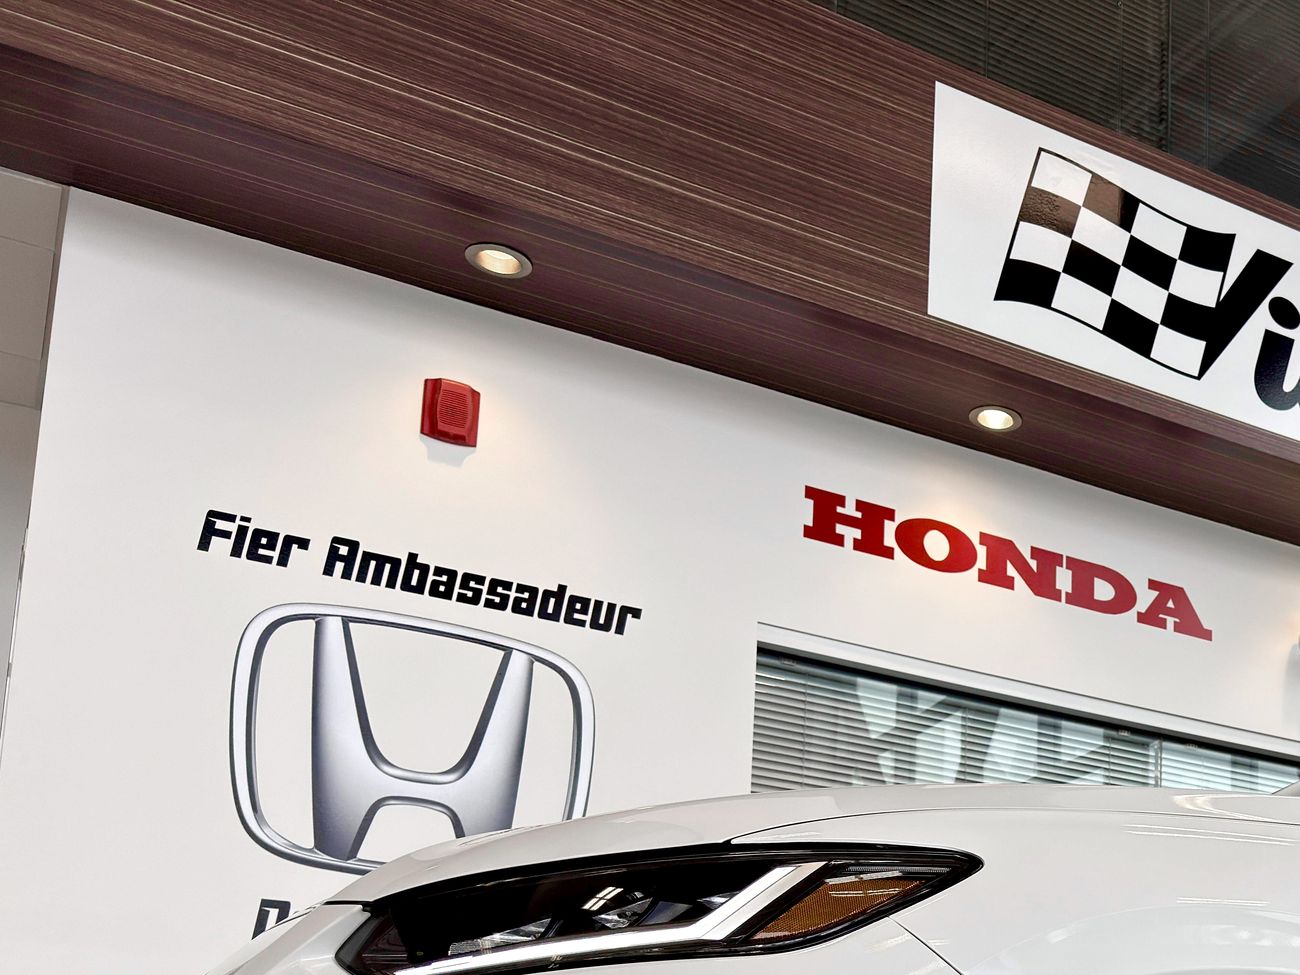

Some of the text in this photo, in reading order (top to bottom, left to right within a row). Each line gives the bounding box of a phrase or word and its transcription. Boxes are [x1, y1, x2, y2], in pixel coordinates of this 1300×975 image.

[196, 509, 643, 637] Fier Ambassadeur
[803, 486, 1212, 641] HONDA
